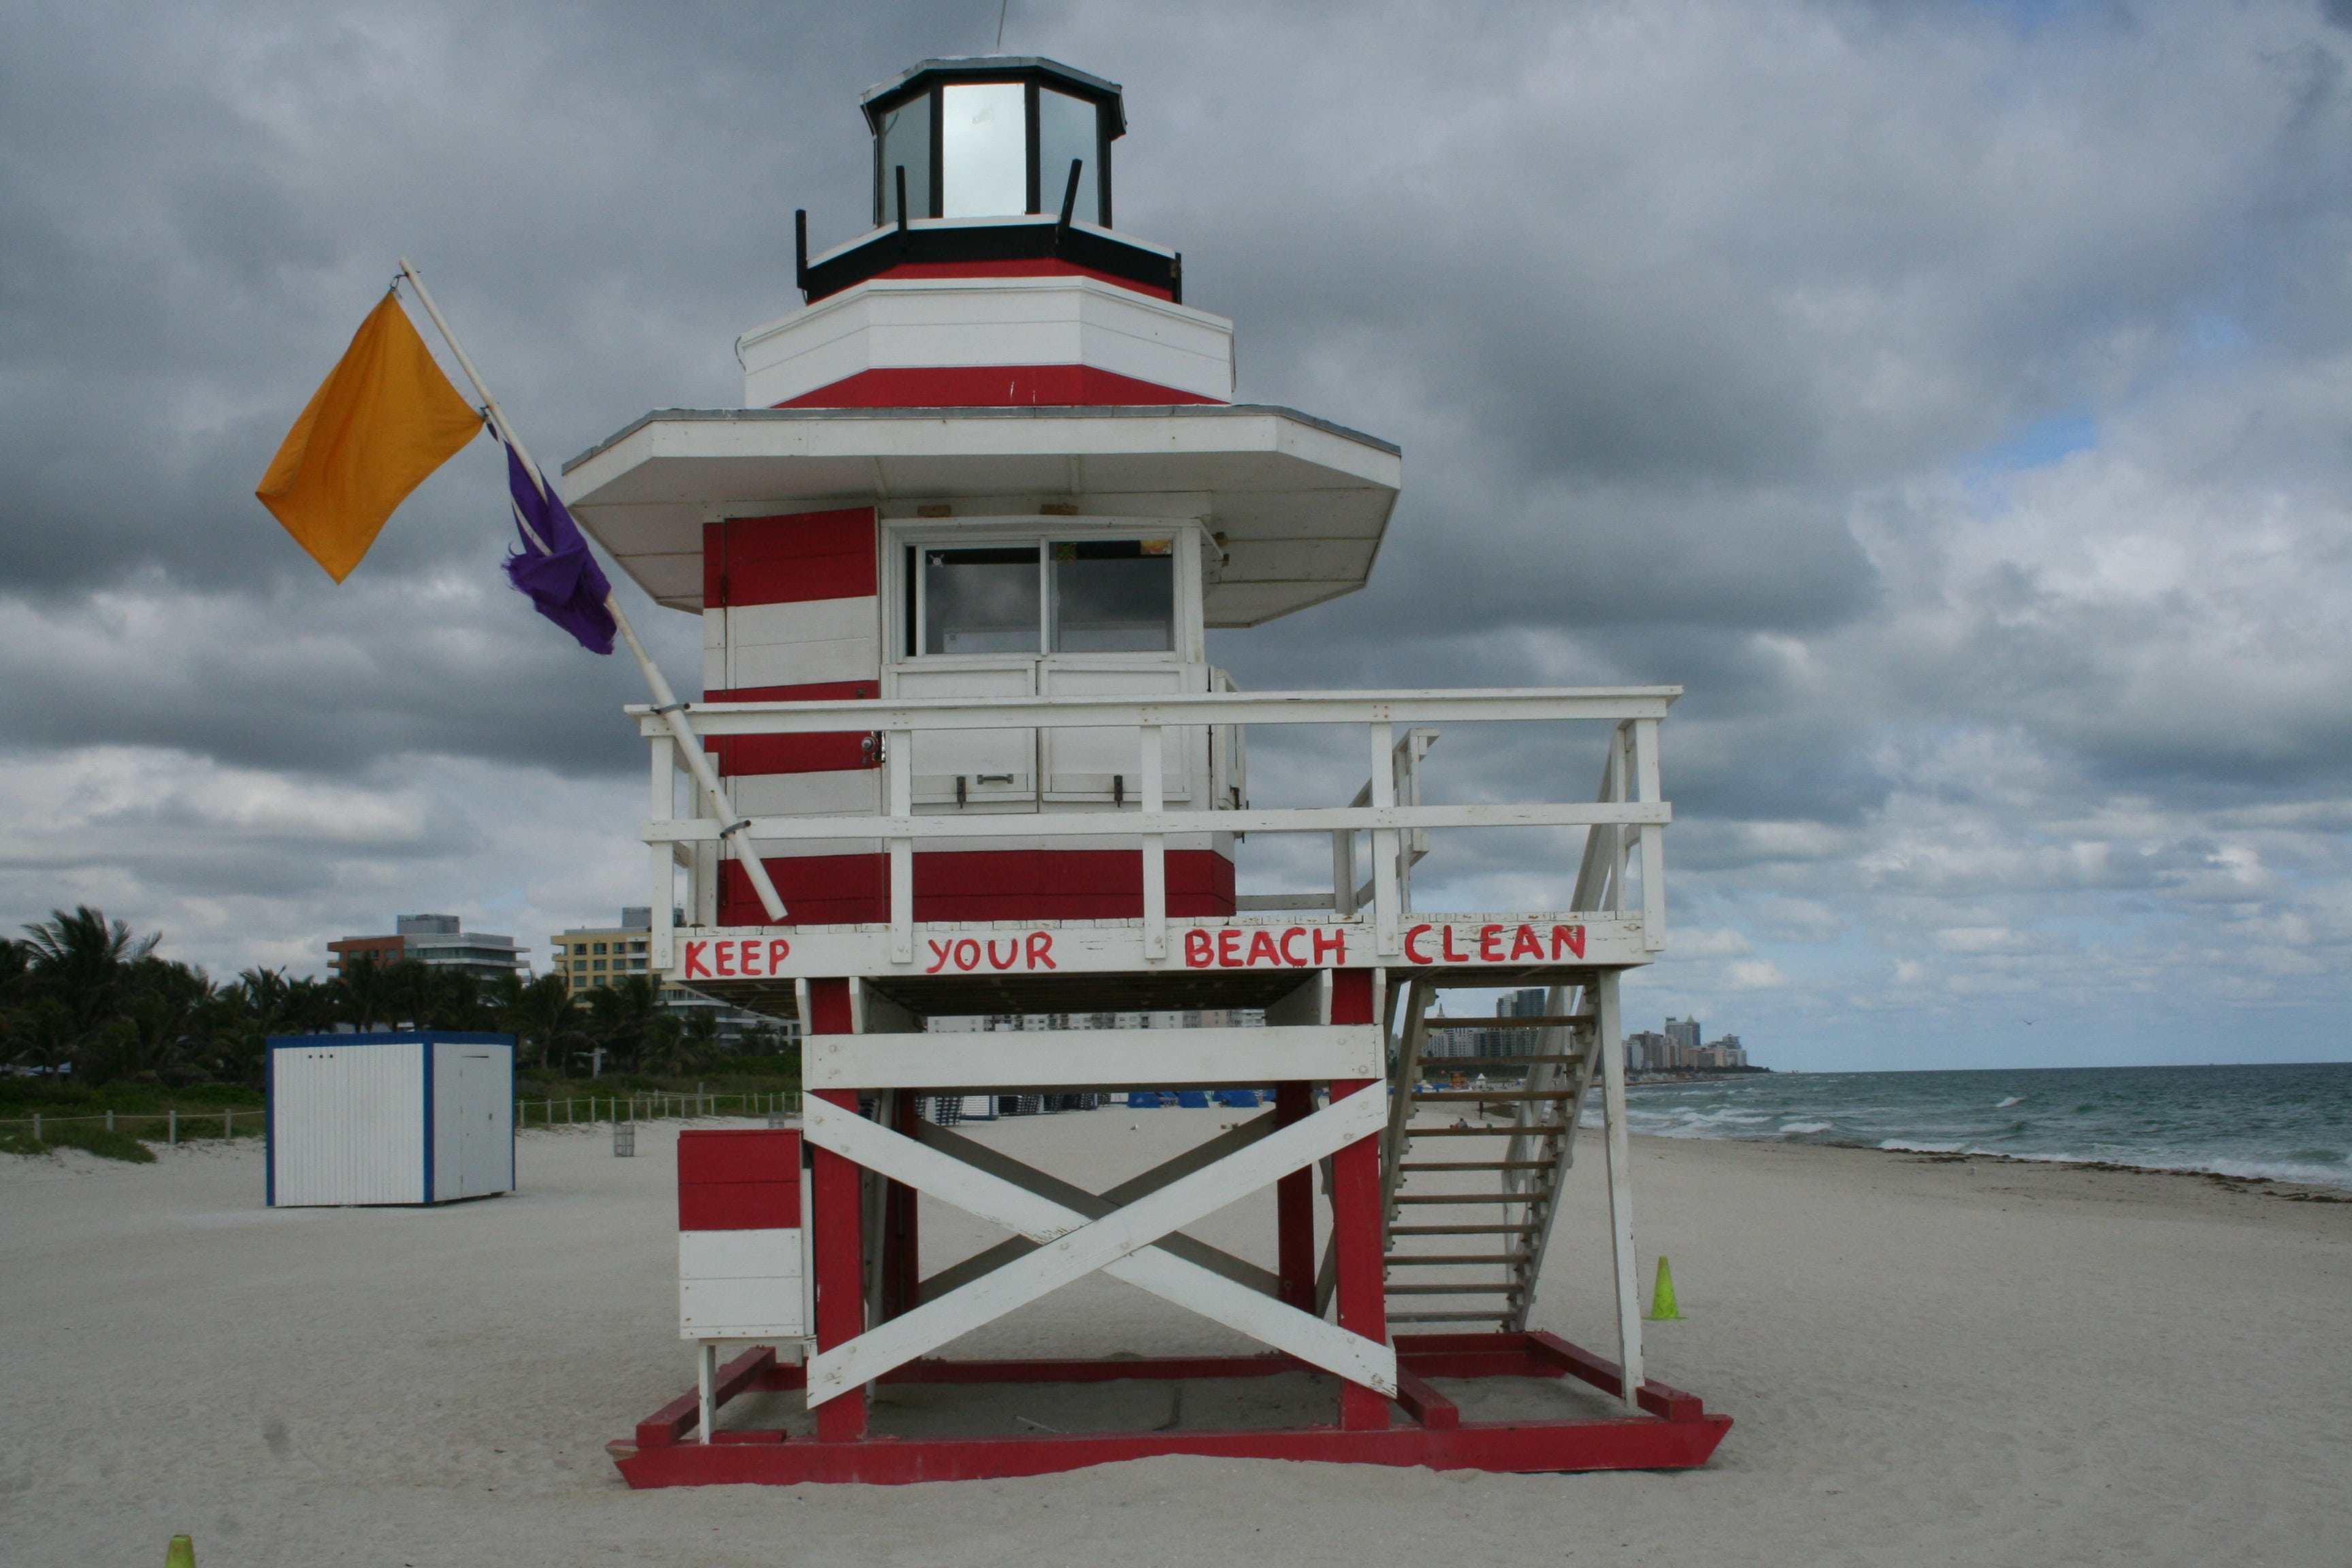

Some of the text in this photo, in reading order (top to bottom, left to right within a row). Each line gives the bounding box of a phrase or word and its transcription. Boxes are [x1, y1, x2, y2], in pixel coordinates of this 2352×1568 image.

[685, 924, 1586, 979] KEEP YOUR BEACH CLEAN
